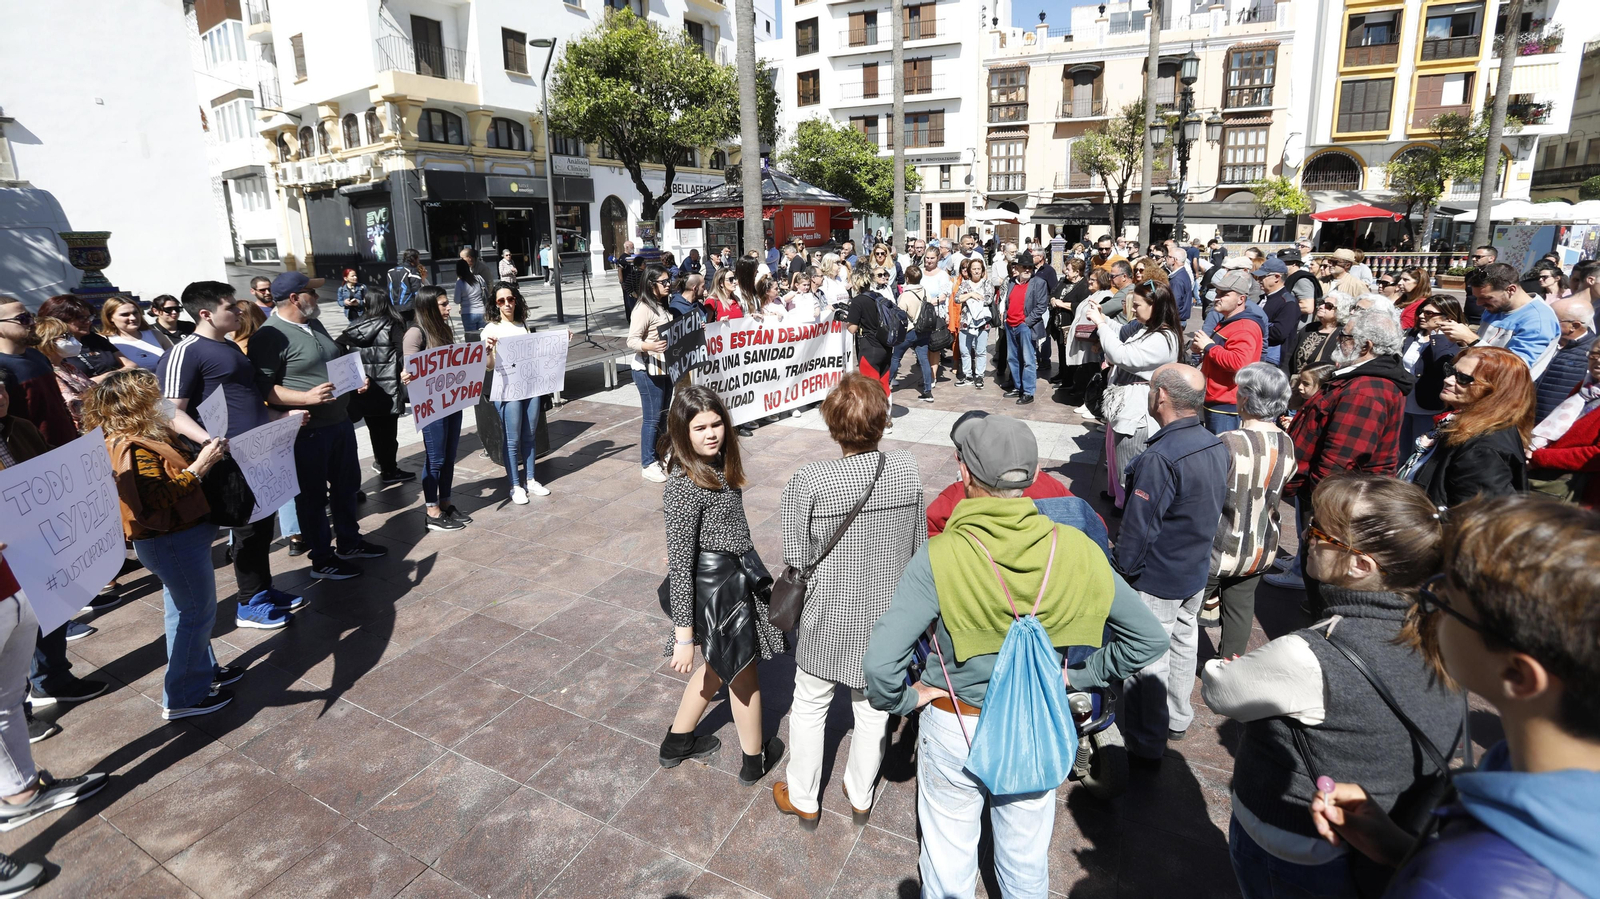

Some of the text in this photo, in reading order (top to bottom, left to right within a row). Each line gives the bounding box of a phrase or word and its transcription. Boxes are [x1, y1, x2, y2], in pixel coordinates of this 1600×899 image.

[672, 183, 712, 194] BELLAFEM
[366, 207, 389, 226] EVO
[793, 212, 815, 228] ¡HOLA!
[660, 311, 702, 350] JUSTICIA
[730, 325, 774, 349] ESTÁN
[777, 321, 829, 344] DEJANDO
[831, 319, 843, 334] M
[410, 343, 483, 381] JUSTICIA
[507, 334, 567, 364] SIEMPRE
[681, 345, 709, 373] LYDIA
[697, 346, 795, 379] POR UNA SANIDAD
[426, 370, 466, 395] TODO
[520, 359, 540, 379] CON
[704, 350, 852, 395] ÚBLICA DIGNA, TRANSPARE Y
[496, 371, 557, 400] NOSOTROS
[726, 370, 846, 412] LIDAD NO LO PERMI
[413, 380, 482, 424] POR LYDIA
[2, 444, 111, 517] TODO POR
[247, 458, 274, 489] POR
[252, 470, 293, 515] YDIA
[38, 482, 116, 556] LYDIA
